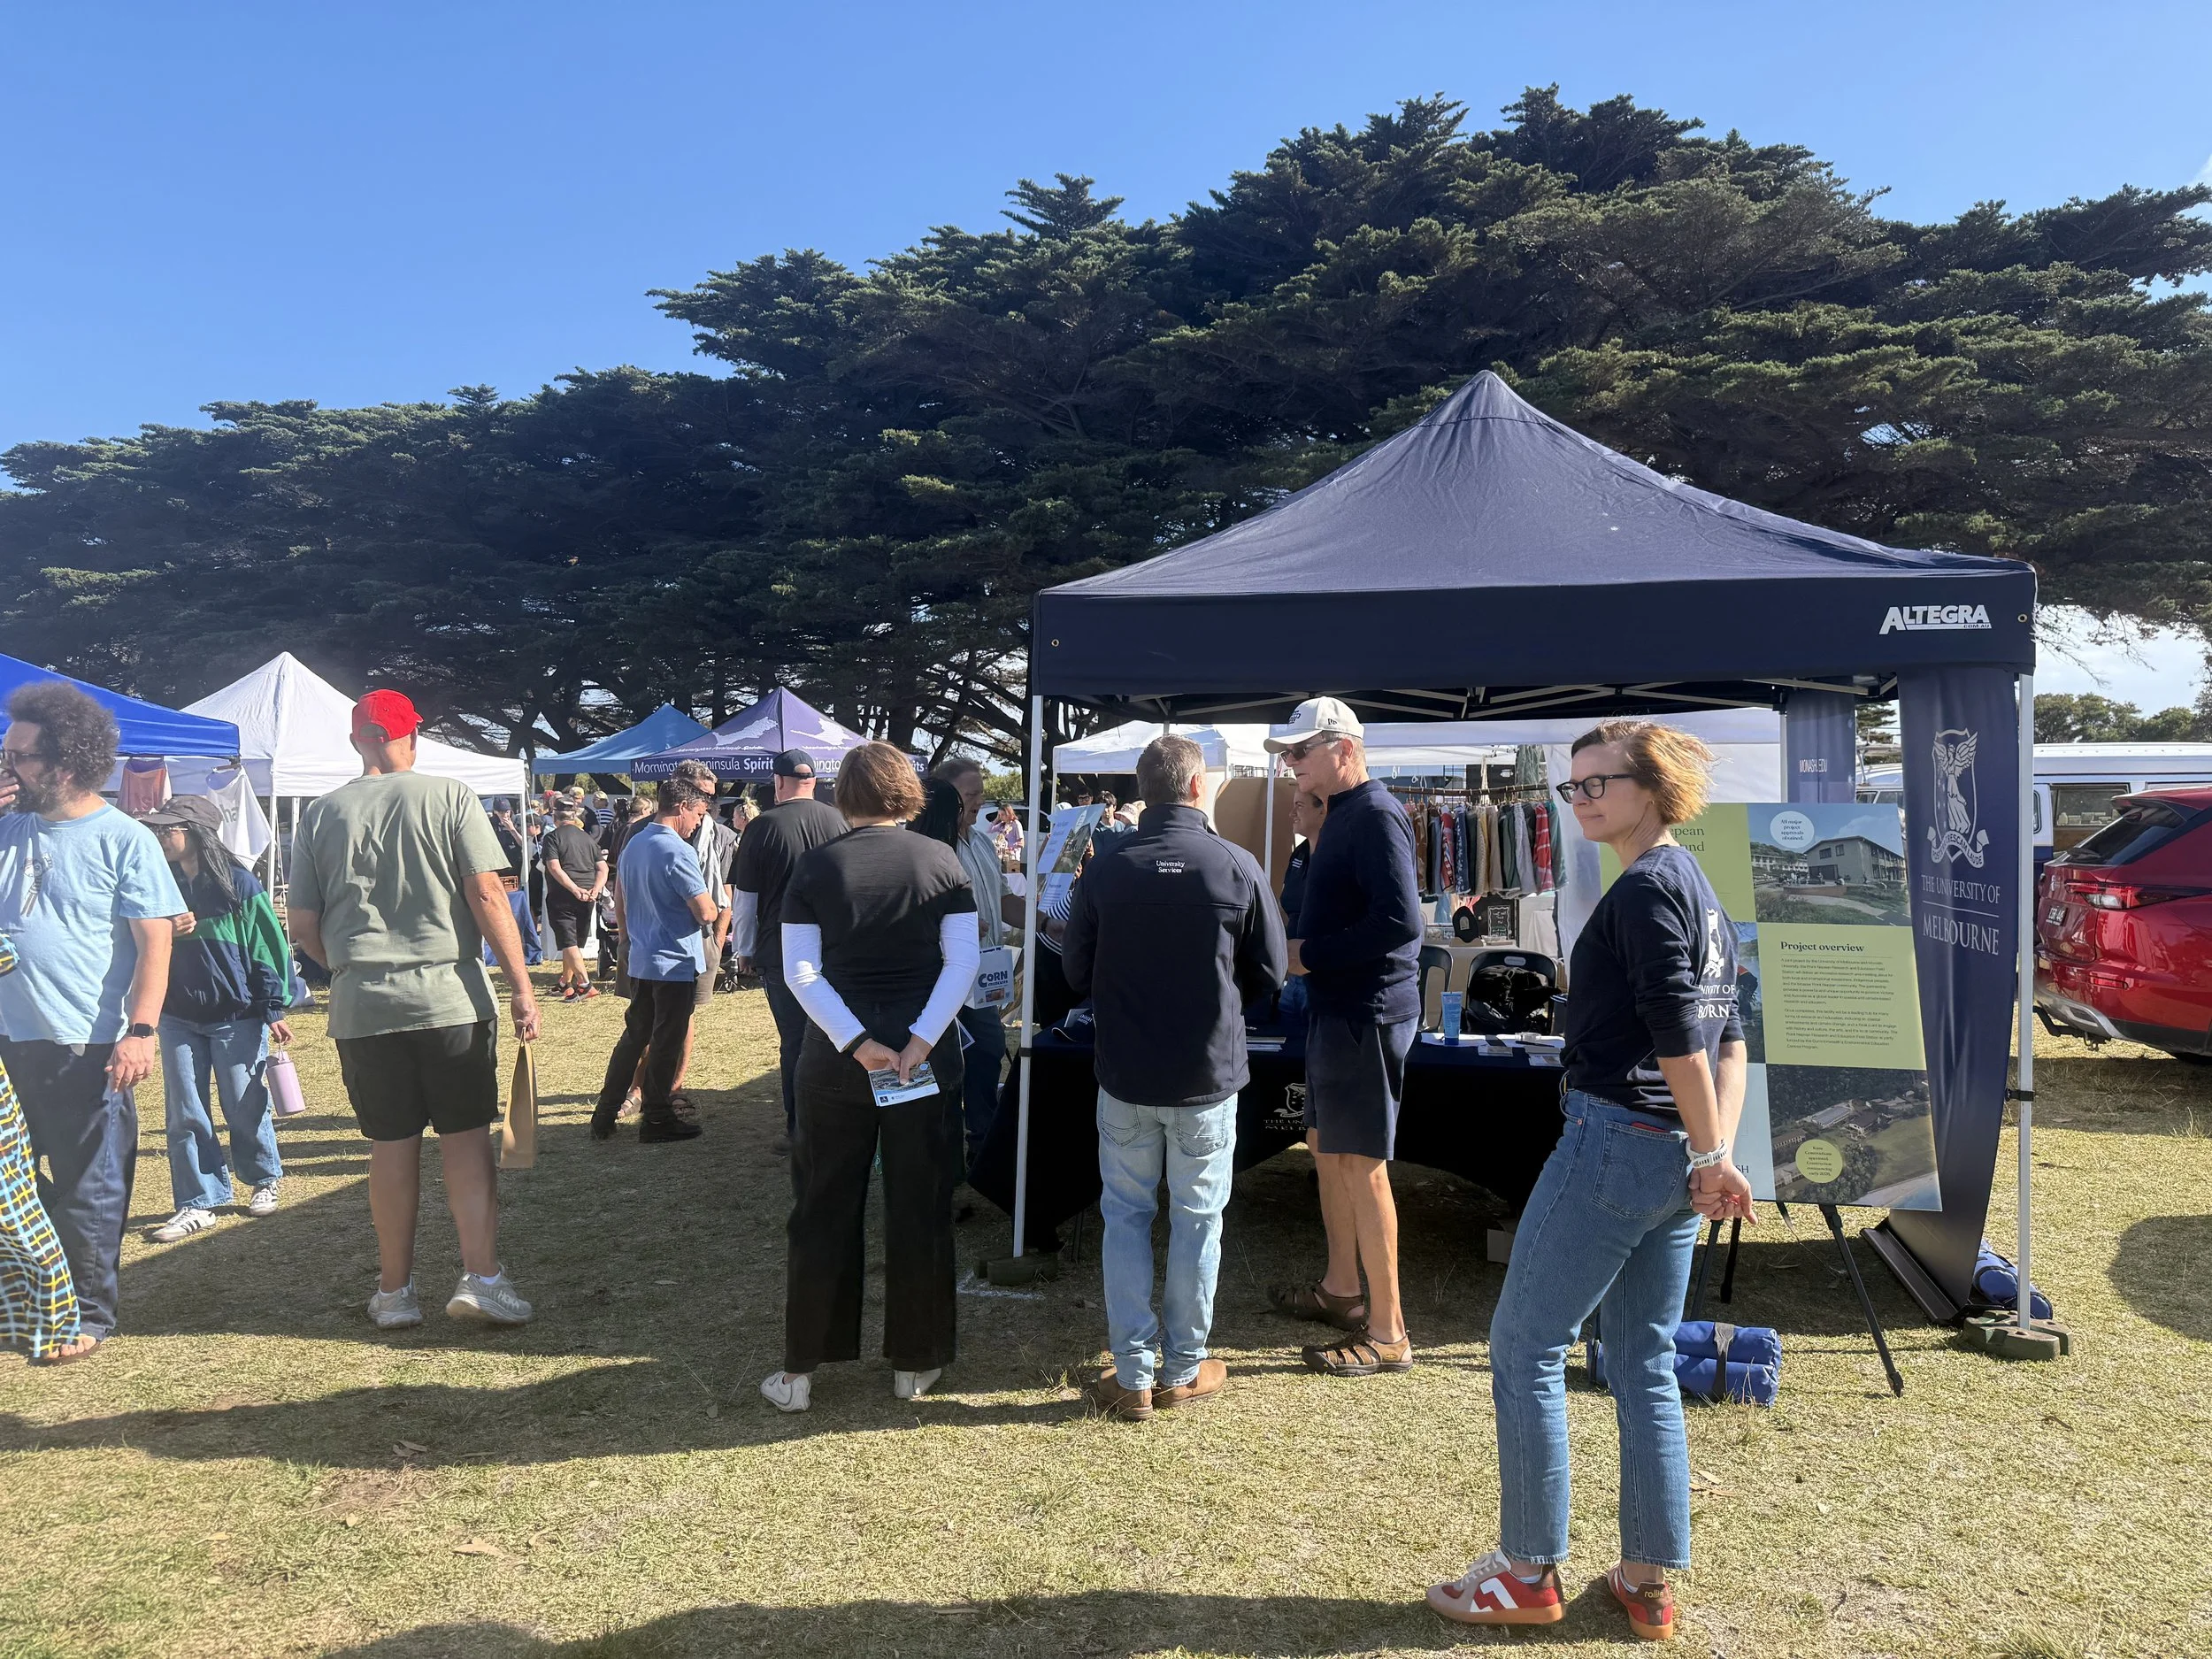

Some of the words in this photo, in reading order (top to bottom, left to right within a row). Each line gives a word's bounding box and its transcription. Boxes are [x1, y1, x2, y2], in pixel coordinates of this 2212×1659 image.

[1878, 604, 1991, 635] ALTEGRA
[634, 760, 679, 776] Morningt
[743, 757, 773, 772] Spirit
[1921, 874, 1935, 893] THE
[1936, 877, 1986, 902] UNIVERSITY
[1987, 885, 2001, 904] OF
[1923, 912, 2000, 956] MELBOURNE
[1780, 941, 1816, 952] Project
[1819, 943, 1864, 952] overview
[978, 970, 1008, 988] CORN
